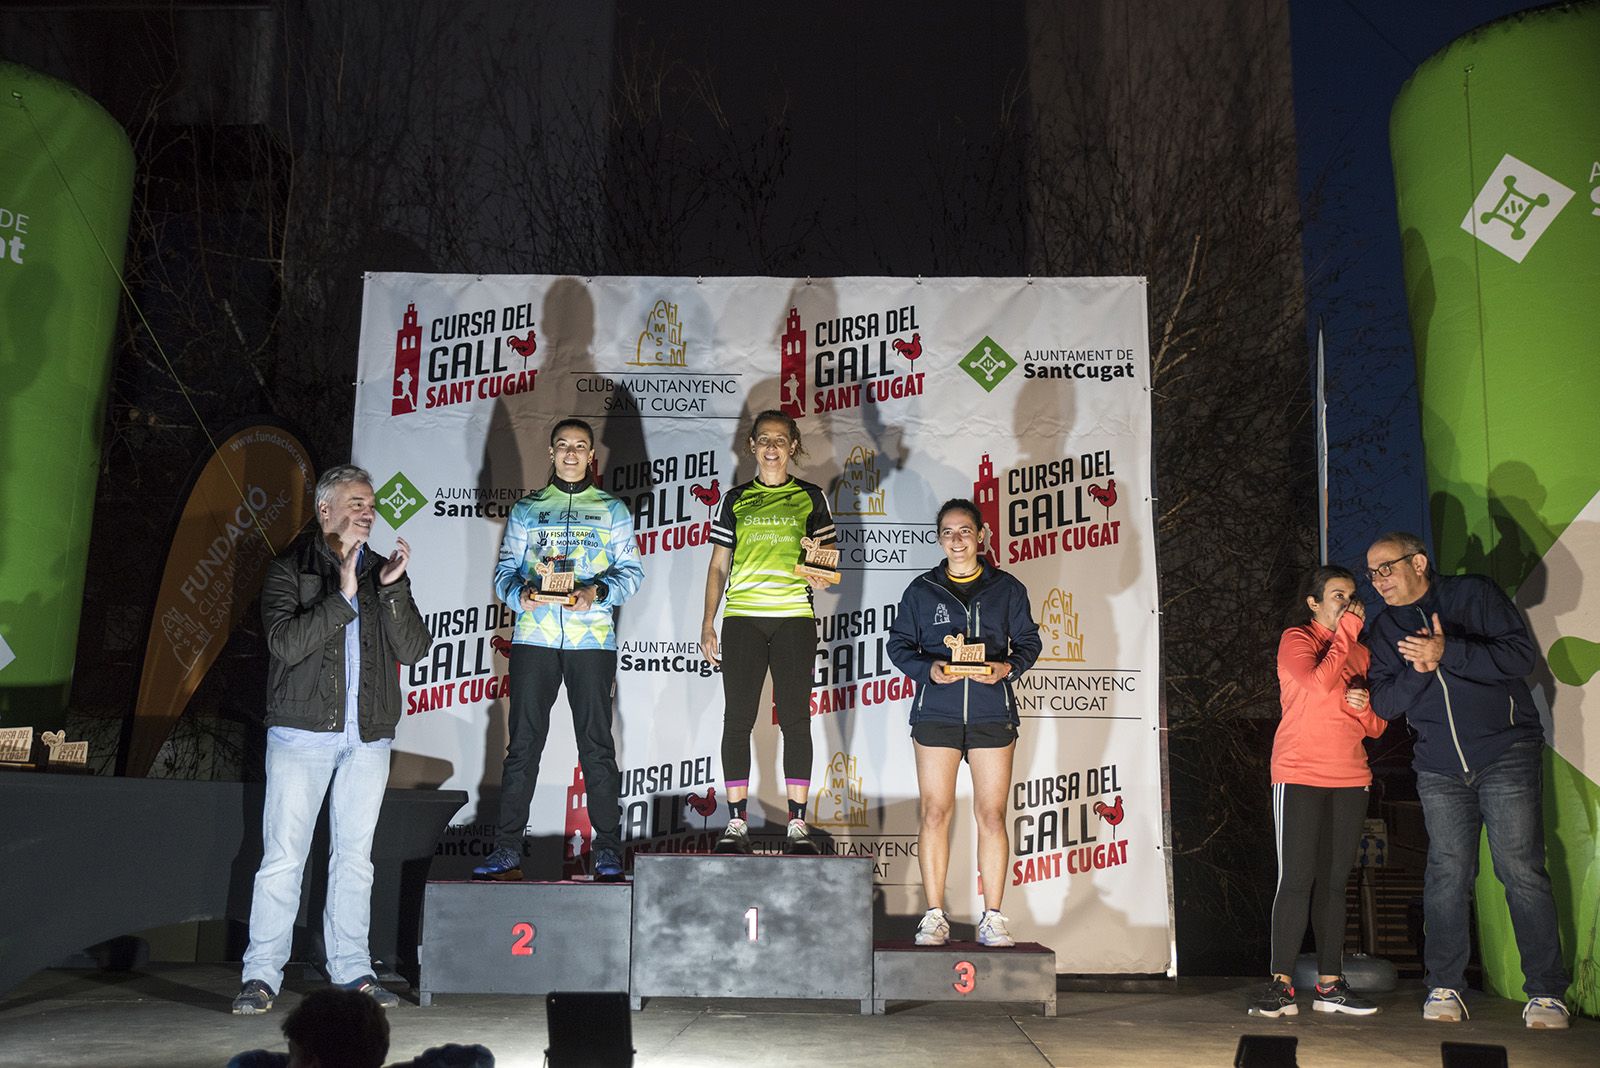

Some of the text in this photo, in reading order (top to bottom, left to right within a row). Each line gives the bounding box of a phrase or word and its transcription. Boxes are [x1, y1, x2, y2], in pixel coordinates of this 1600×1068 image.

[430, 302, 536, 343] CURSA DEL
[814, 304, 920, 347] CURSA DEL
[428, 336, 509, 383] GALL
[813, 340, 895, 388] GALL
[1023, 348, 1135, 363] AJUNTAMENT DE
[1023, 360, 1135, 382] SantCugat
[425, 369, 538, 409] SANT CUGAT
[575, 377, 737, 395] CLUB MUNTANYENC
[603, 396, 708, 413] SANT CUGAT
[813, 371, 926, 414] SANT CUGAT
[612, 449, 719, 492] CURSA DEL
[1008, 449, 1115, 495] CURSA DEL
[433, 500, 510, 518] SantCu
[434, 486, 527, 500] AJUNTAMENT
[1008, 486, 1091, 537] GALL
[550, 530, 595, 539] FISIOTERAPIA
[635, 521, 712, 556] NT CUGA
[743, 514, 799, 527] Santvi
[837, 528, 937, 545] UNTANYENC
[180, 484, 268, 604] FUNDACIÓ
[850, 548, 908, 564] CUGAT
[1008, 520, 1121, 564] SANT CUGAT
[199, 581, 227, 617] CLUB
[209, 584, 237, 630] SANT
[424, 606, 479, 640] URSA
[408, 637, 491, 687] GALL
[813, 637, 892, 689] GALL
[407, 675, 511, 716] SANT CUGA
[809, 675, 914, 717] SANT CUGA
[1014, 695, 1108, 712] ANT CUGAT
[1017, 675, 1136, 692] MUNTANYENC
[0, 739, 29, 752] ALL
[58, 750, 86, 760] GALL
[618, 756, 715, 798] URSA DEL
[1013, 764, 1122, 811] CURSA DEL
[618, 795, 687, 843] ALL
[1013, 803, 1098, 856] GALL
[1012, 838, 1129, 886] SANT CUGAT
[510, 921, 535, 956] 2
[744, 906, 759, 942] 1
[952, 960, 977, 994] 3
